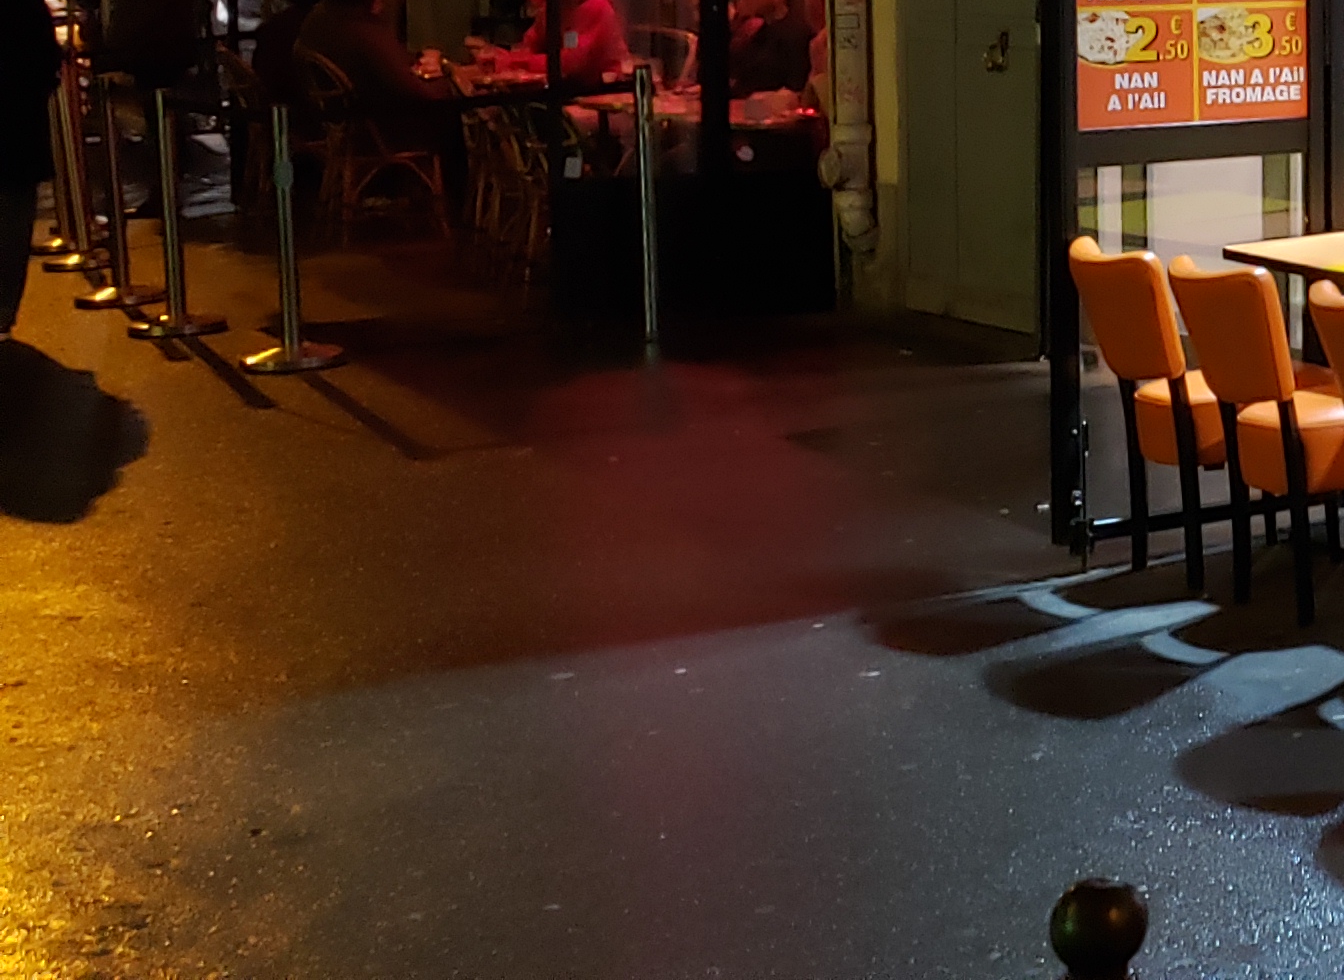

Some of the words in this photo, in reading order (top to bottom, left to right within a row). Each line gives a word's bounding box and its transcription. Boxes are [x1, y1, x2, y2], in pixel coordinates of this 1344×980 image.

[1114, 72, 1158, 90] NAN
[1202, 69, 1245, 86] NAN
[1250, 68, 1263, 84] A
[1107, 94, 1122, 112] A
[1206, 85, 1302, 105] FROMAGE
